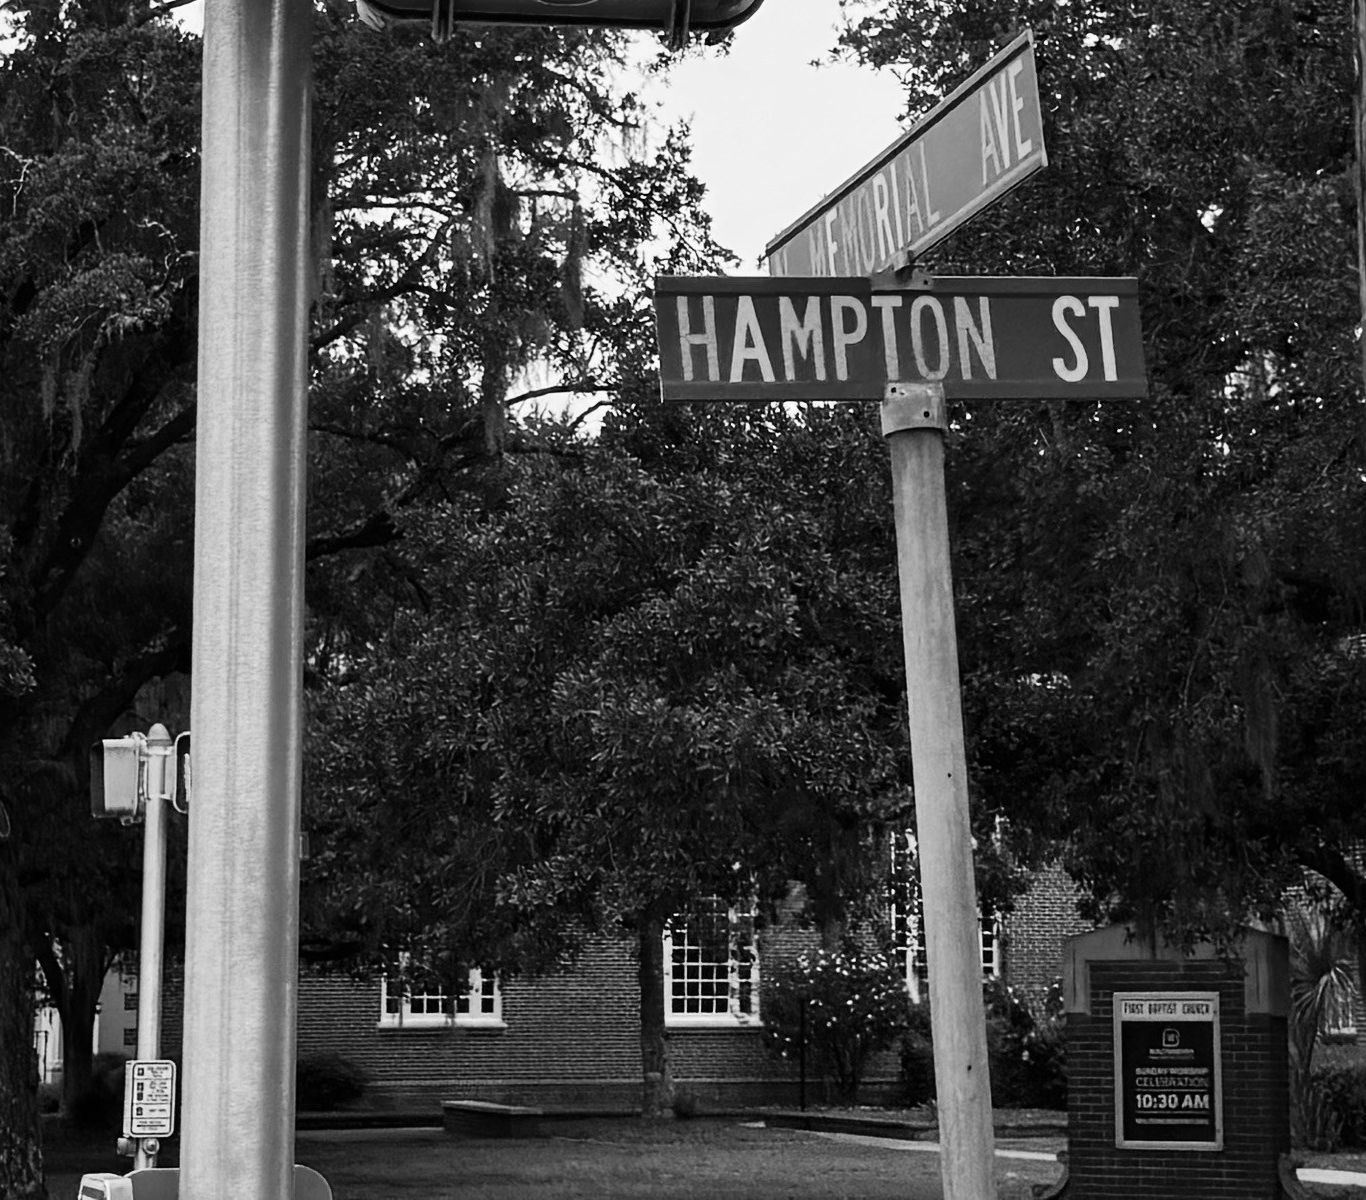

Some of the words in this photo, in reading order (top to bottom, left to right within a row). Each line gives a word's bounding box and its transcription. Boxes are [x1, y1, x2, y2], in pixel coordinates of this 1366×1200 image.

[979, 59, 1033, 186] AVE
[675, 295, 997, 383] HAMPTON
[1051, 294, 1120, 383] ST
[1135, 1093, 1178, 1109] 10:30
[1181, 1093, 1210, 1109] AM
